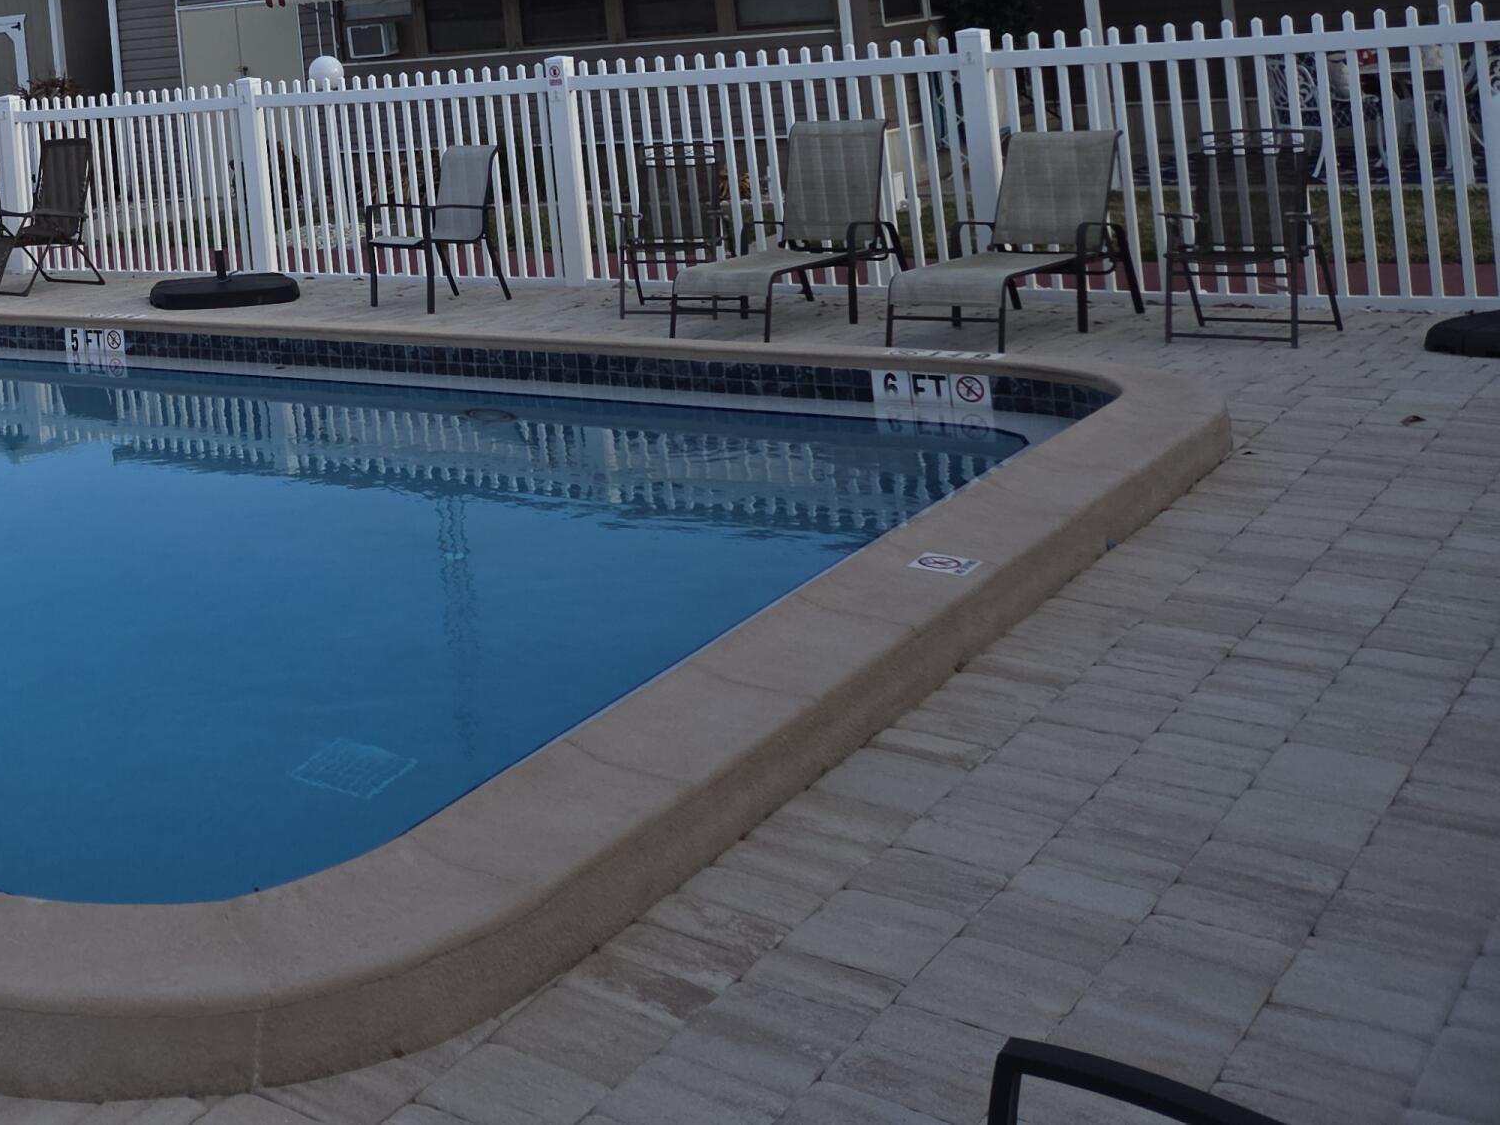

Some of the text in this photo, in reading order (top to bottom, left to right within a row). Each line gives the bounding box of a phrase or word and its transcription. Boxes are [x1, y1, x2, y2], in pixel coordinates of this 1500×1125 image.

[71, 329, 102, 352] 5 FT
[883, 372, 947, 397] 6 FT
